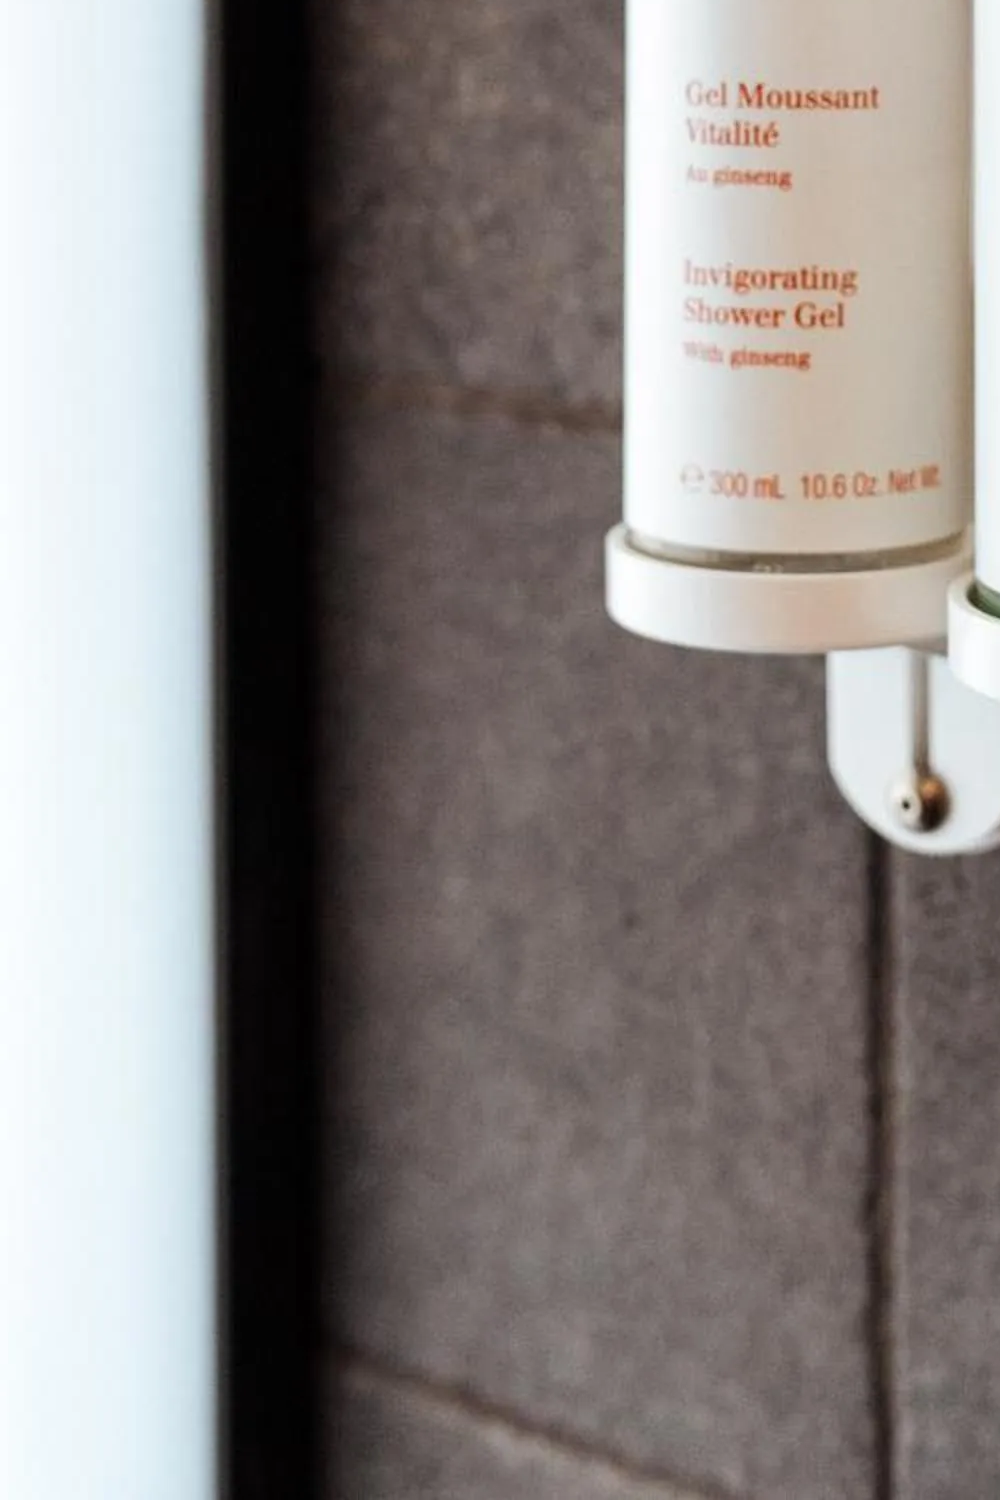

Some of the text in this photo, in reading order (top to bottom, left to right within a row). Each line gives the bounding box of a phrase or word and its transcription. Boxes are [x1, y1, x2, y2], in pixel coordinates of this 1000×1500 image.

[685, 80, 880, 110] Gel Moussant
[686, 117, 780, 148] Vitalité
[686, 164, 793, 190] Au ginseng
[683, 260, 858, 296] Invigorating
[683, 298, 845, 328] Shower Gel
[682, 340, 812, 371] With ginseng
[709, 470, 748, 498] 300
[800, 474, 848, 499] 10.6
